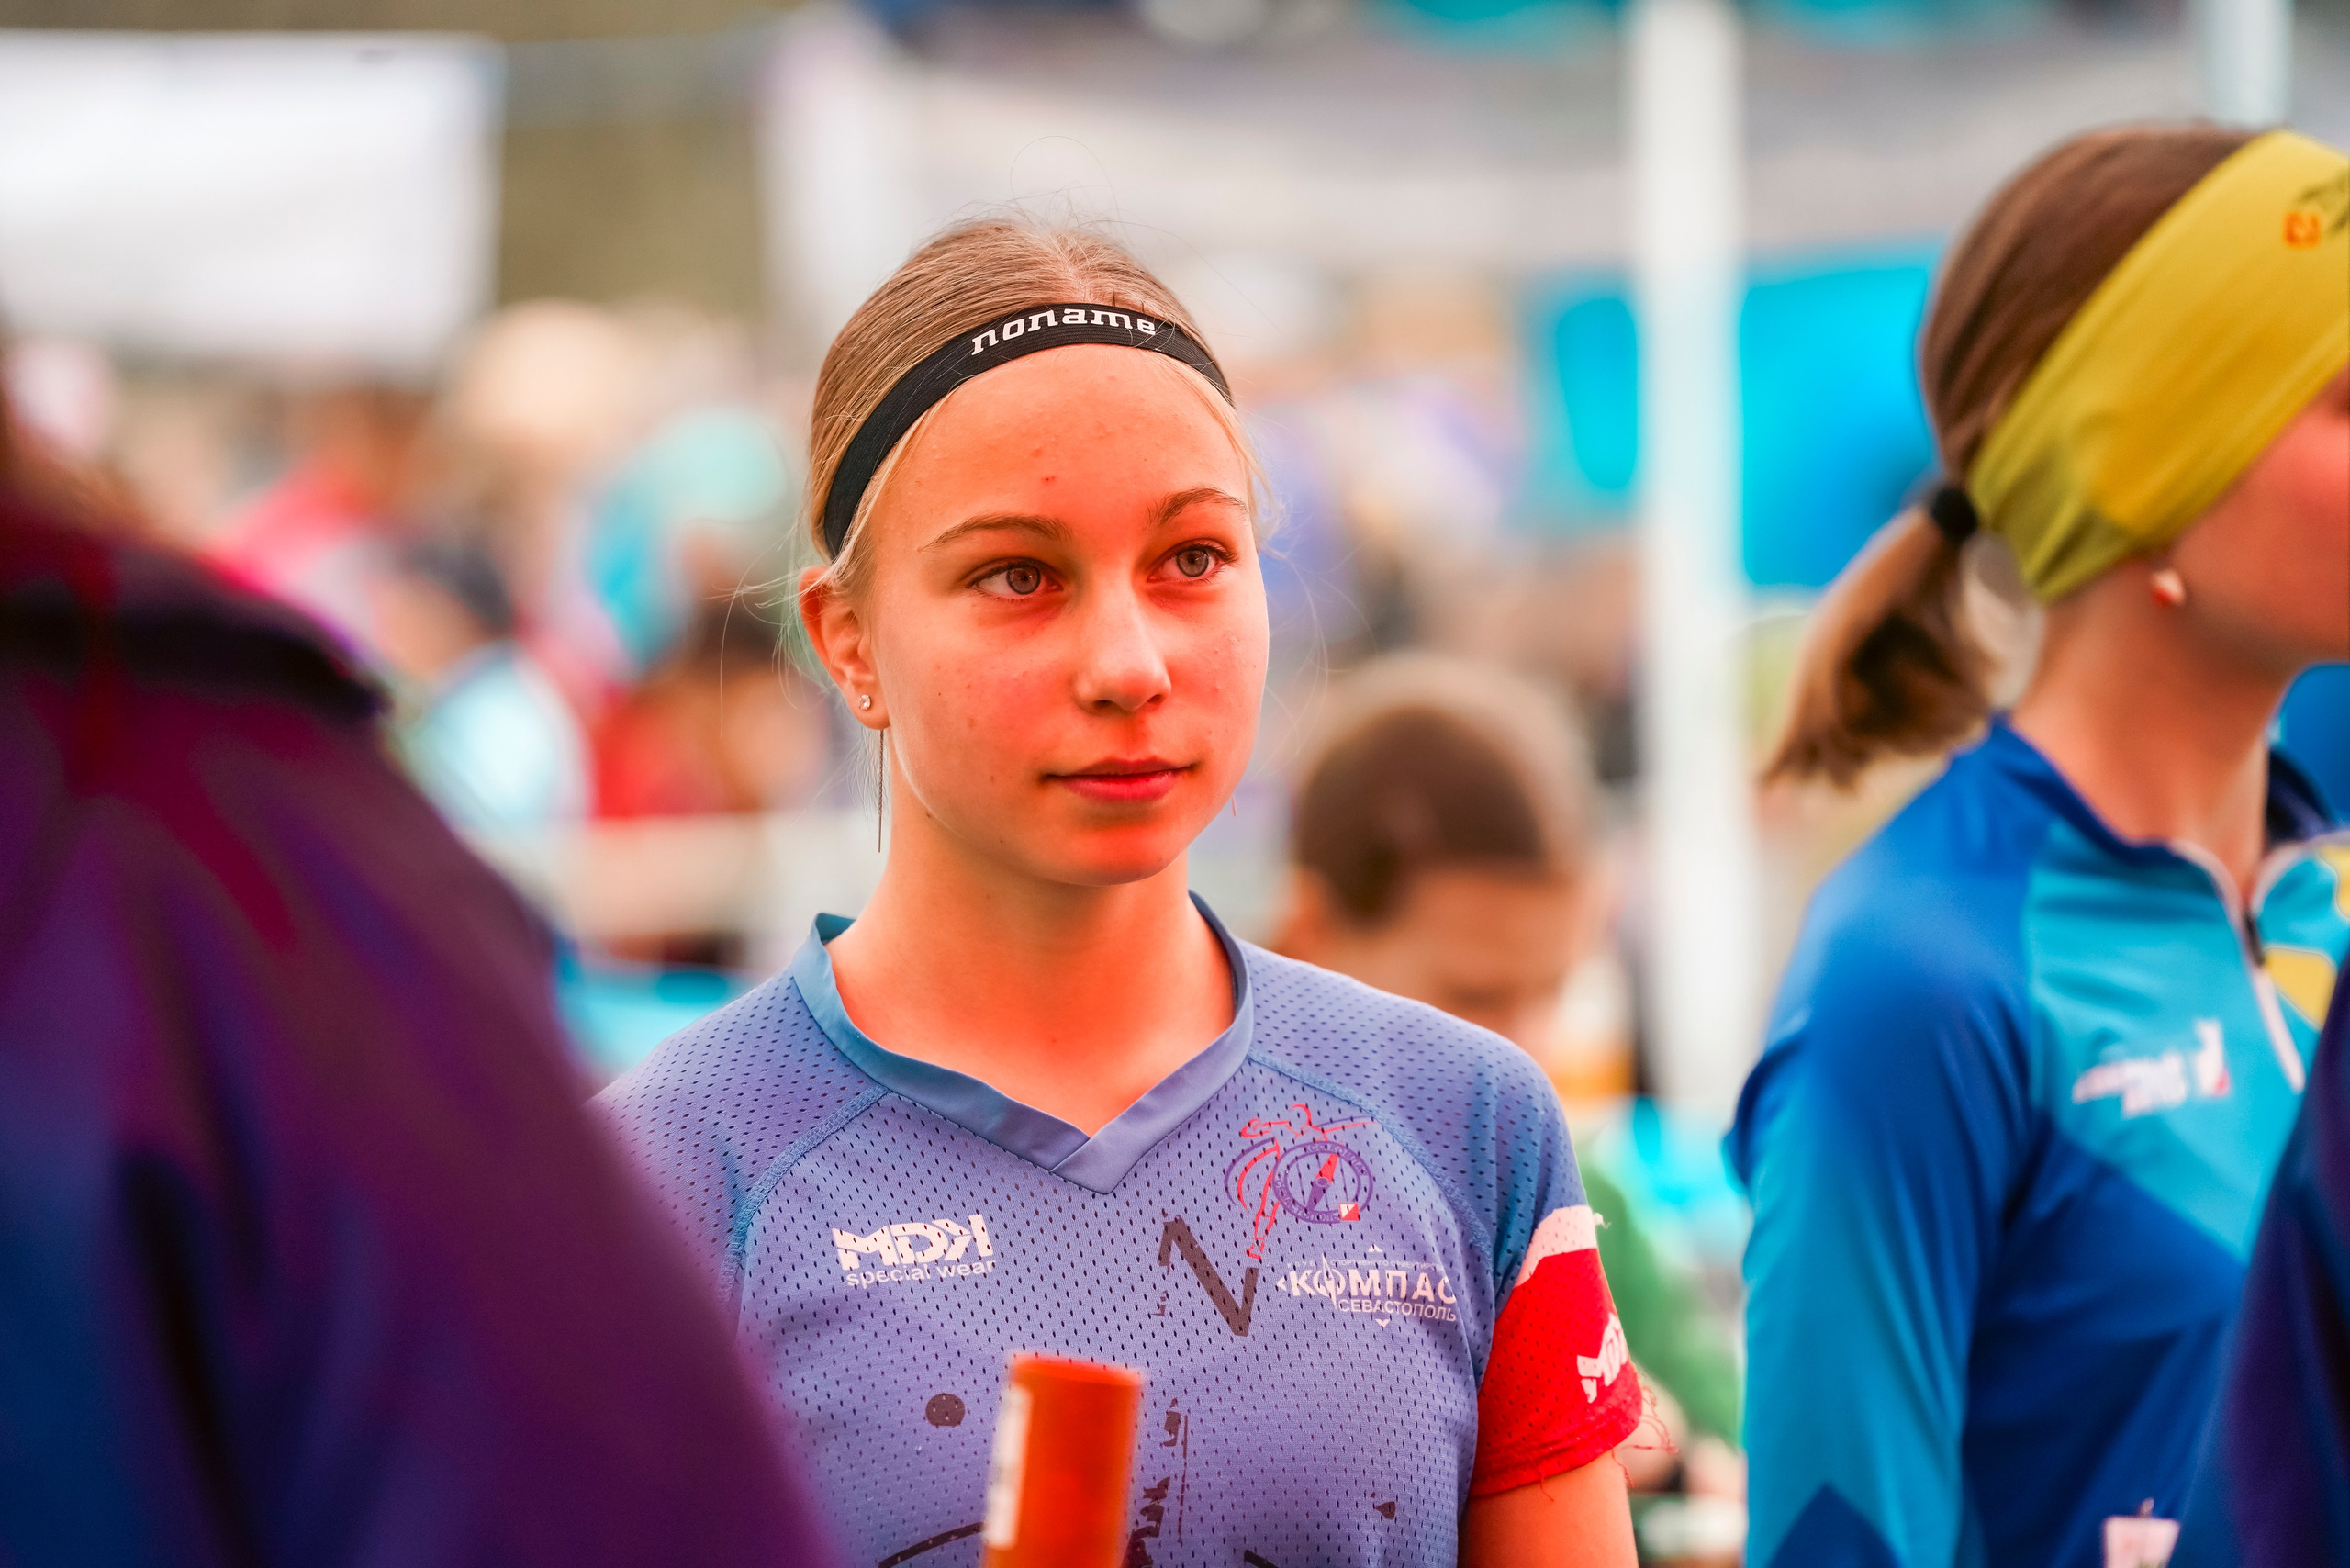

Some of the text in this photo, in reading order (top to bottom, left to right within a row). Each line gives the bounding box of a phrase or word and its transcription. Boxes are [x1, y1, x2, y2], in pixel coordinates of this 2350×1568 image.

[971, 308, 1157, 356] noname
[846, 1260, 996, 1289] special wear
[1338, 1299, 1457, 1322] СЕВАСТОПОЛЬ
